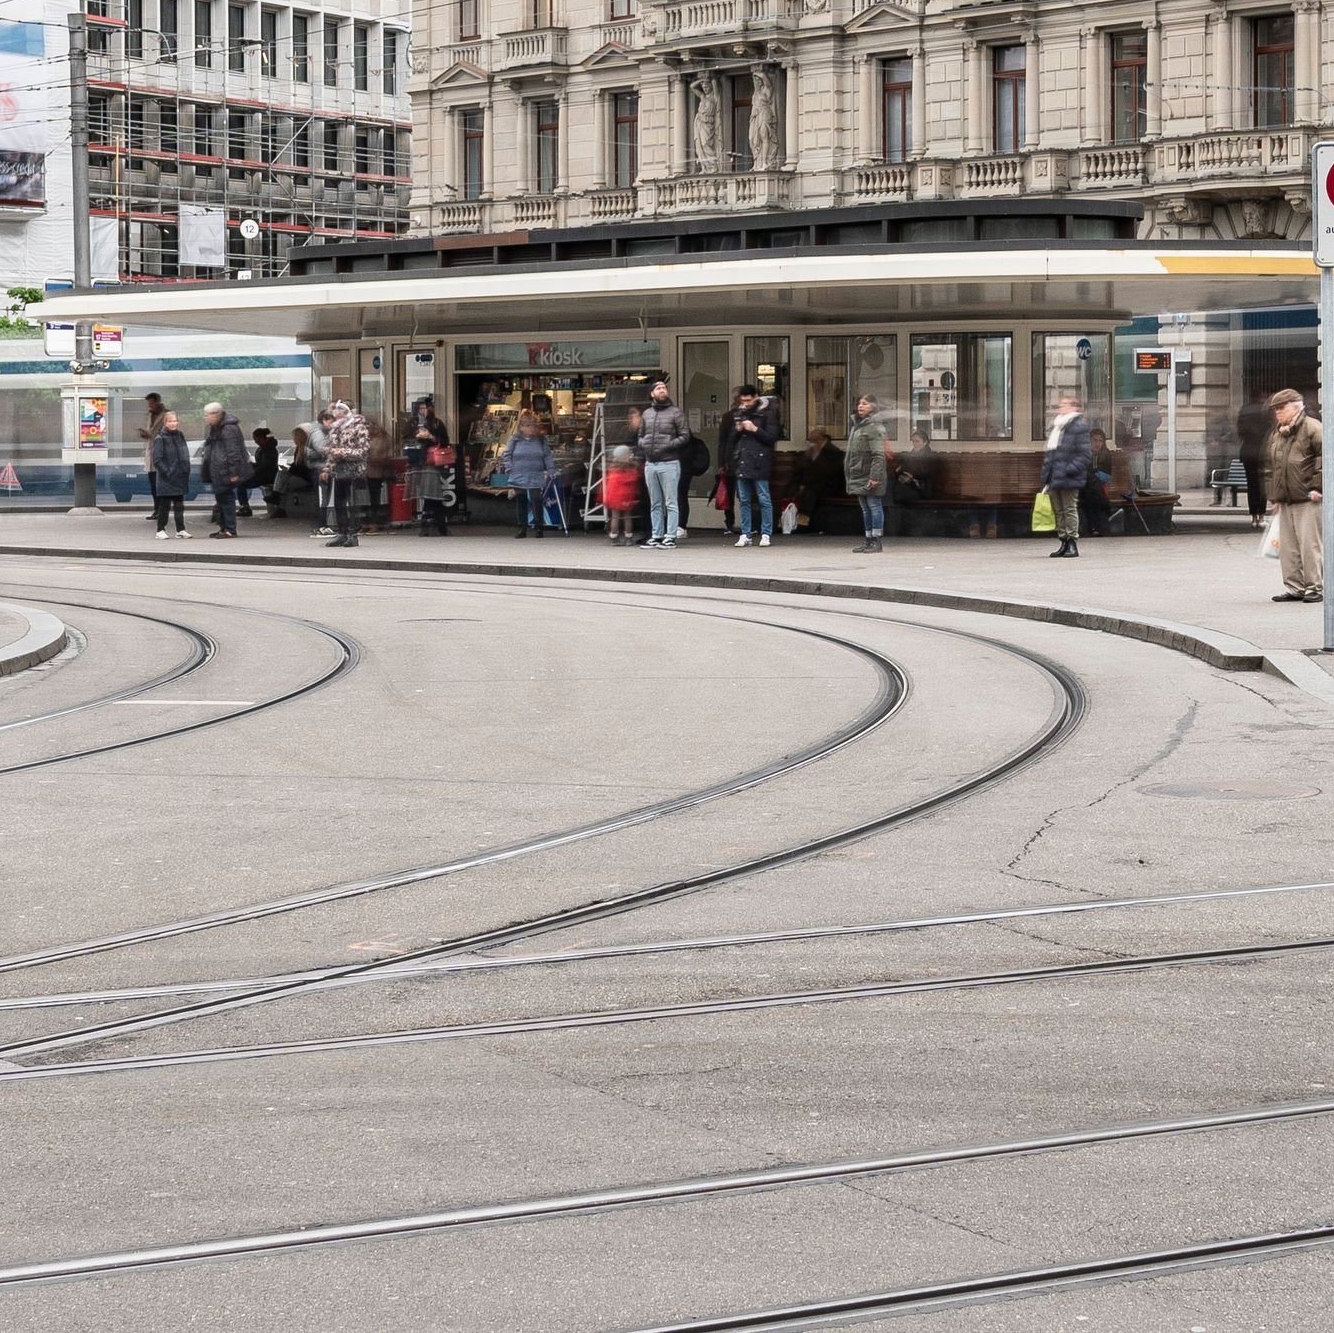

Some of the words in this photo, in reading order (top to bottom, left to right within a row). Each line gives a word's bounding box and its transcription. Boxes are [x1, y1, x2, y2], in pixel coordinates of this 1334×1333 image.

[540, 346, 583, 366] kiosk
[1076, 346, 1092, 357] WC
[440, 467, 457, 507] OK.
